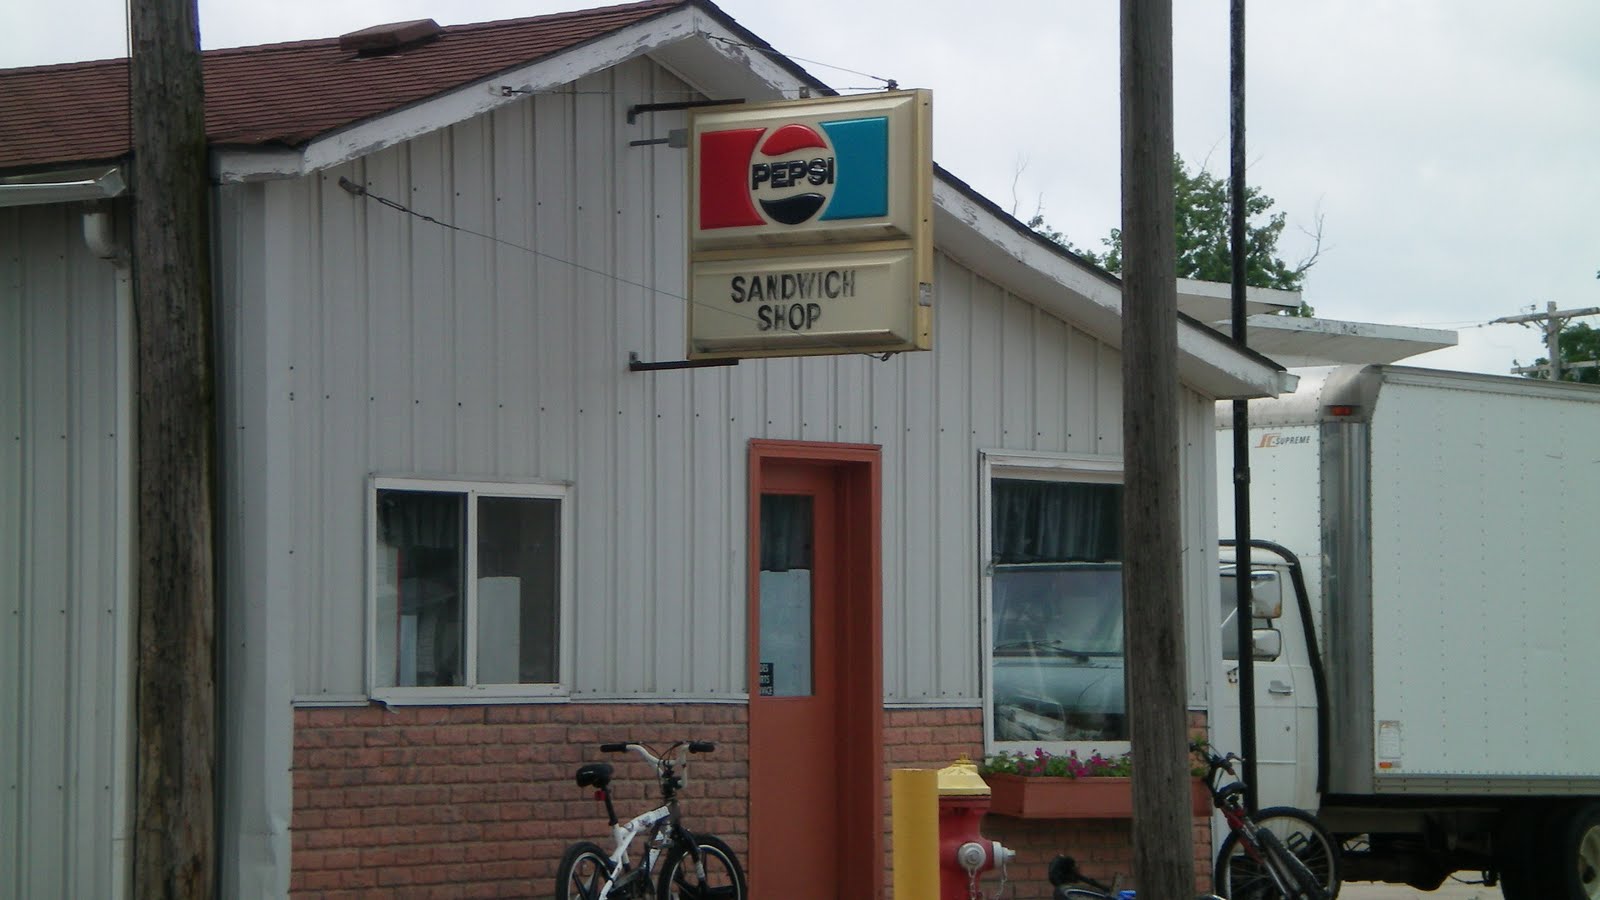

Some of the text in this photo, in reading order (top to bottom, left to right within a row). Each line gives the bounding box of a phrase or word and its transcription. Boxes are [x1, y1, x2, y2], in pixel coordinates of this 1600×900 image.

[752, 157, 834, 190] PEPSI
[731, 270, 856, 303] SANDWICH
[757, 303, 821, 331] SHOP
[1275, 435, 1311, 445] SUPREME
